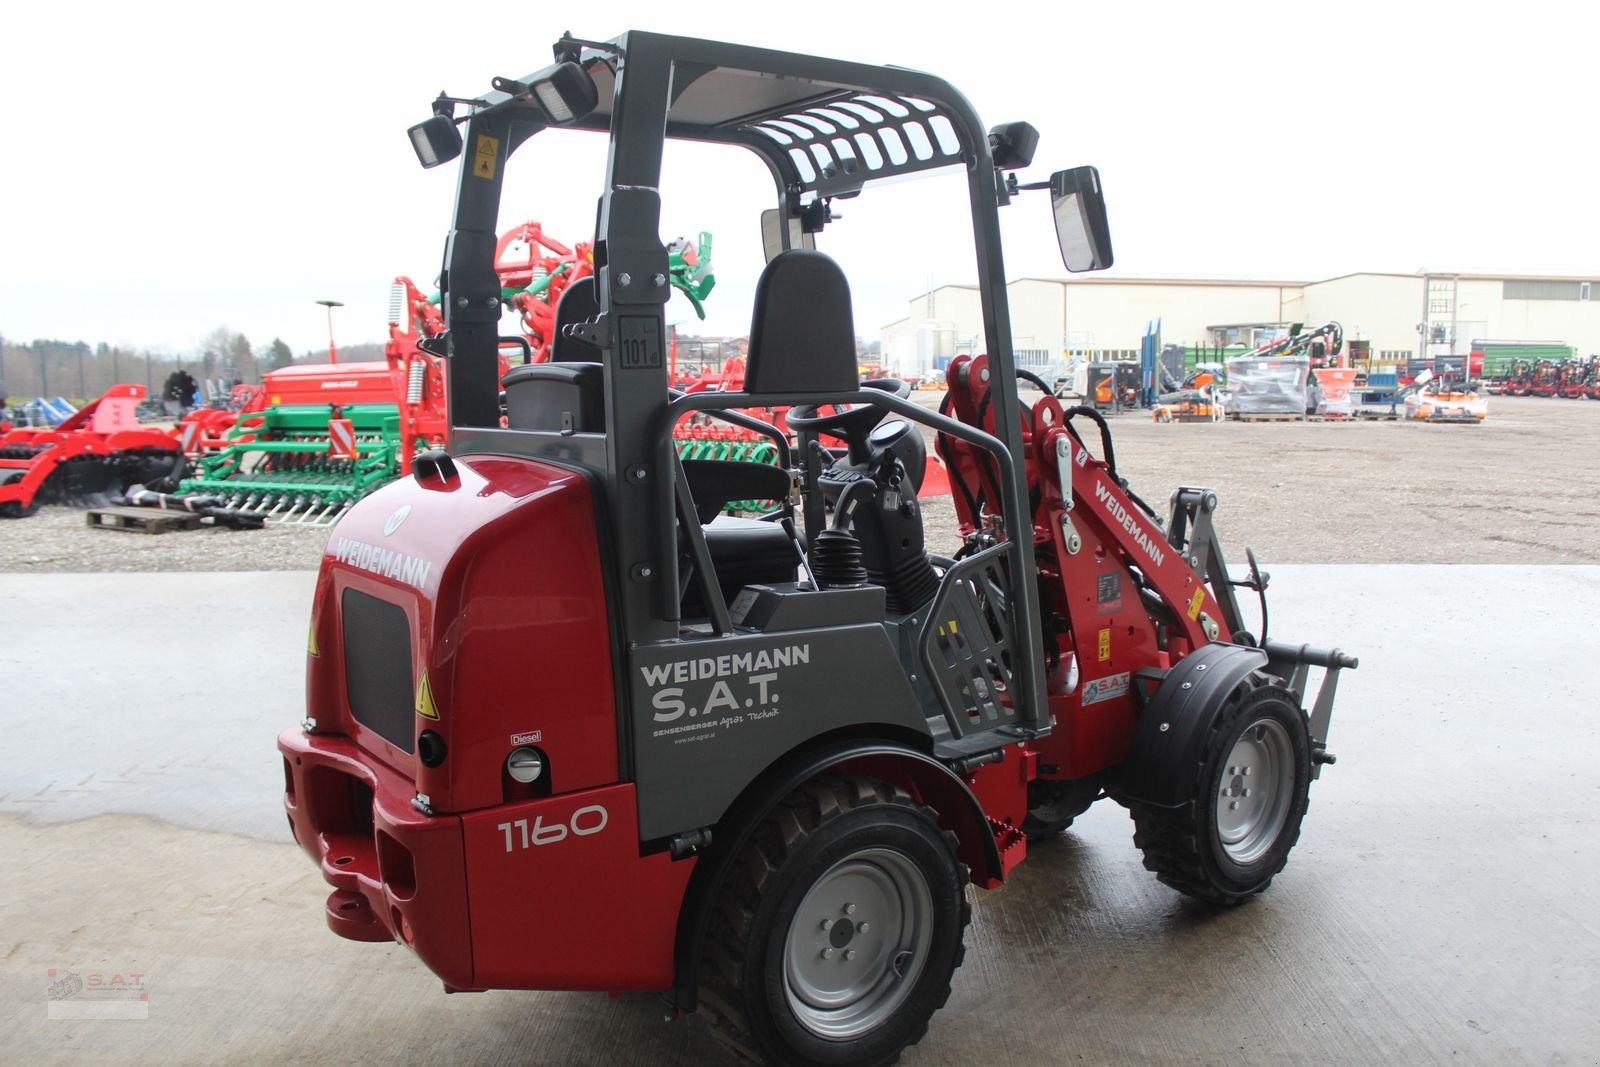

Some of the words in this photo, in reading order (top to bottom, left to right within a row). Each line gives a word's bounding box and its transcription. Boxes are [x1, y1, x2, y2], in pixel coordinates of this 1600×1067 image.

[623, 339, 648, 365] 101
[1095, 479, 1164, 567] WEIDEMANN
[335, 537, 432, 588] WEIDEMANN
[640, 643, 810, 687] WEIDEMANN
[652, 672, 780, 722] S.A.T.
[512, 732, 540, 744] Diesel
[653, 720, 718, 737] SENSENBERGER
[747, 707, 780, 721] Technik
[497, 804, 609, 853] 1160
